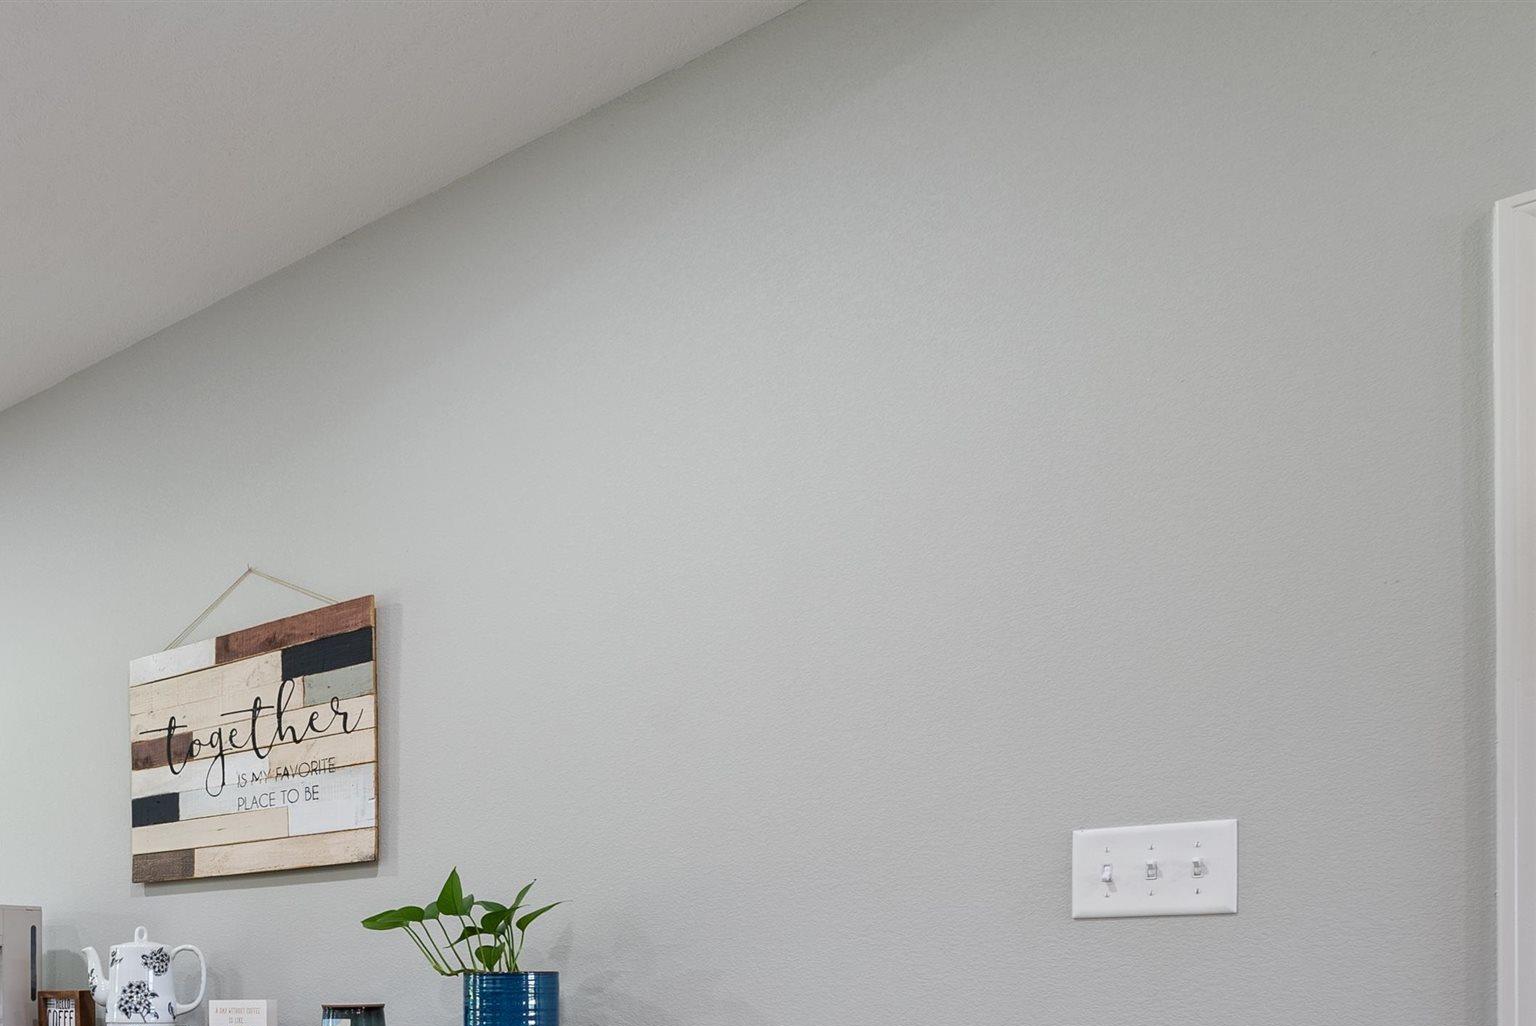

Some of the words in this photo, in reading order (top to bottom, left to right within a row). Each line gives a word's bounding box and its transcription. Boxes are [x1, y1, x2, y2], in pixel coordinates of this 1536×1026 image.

[139, 678, 364, 797] together
[237, 773, 248, 788] IS
[250, 768, 272, 786] MY
[275, 756, 337, 781] FAVORITE
[237, 791, 277, 811] PLACE
[280, 788, 300, 804] TO
[304, 784, 320, 801] BE
